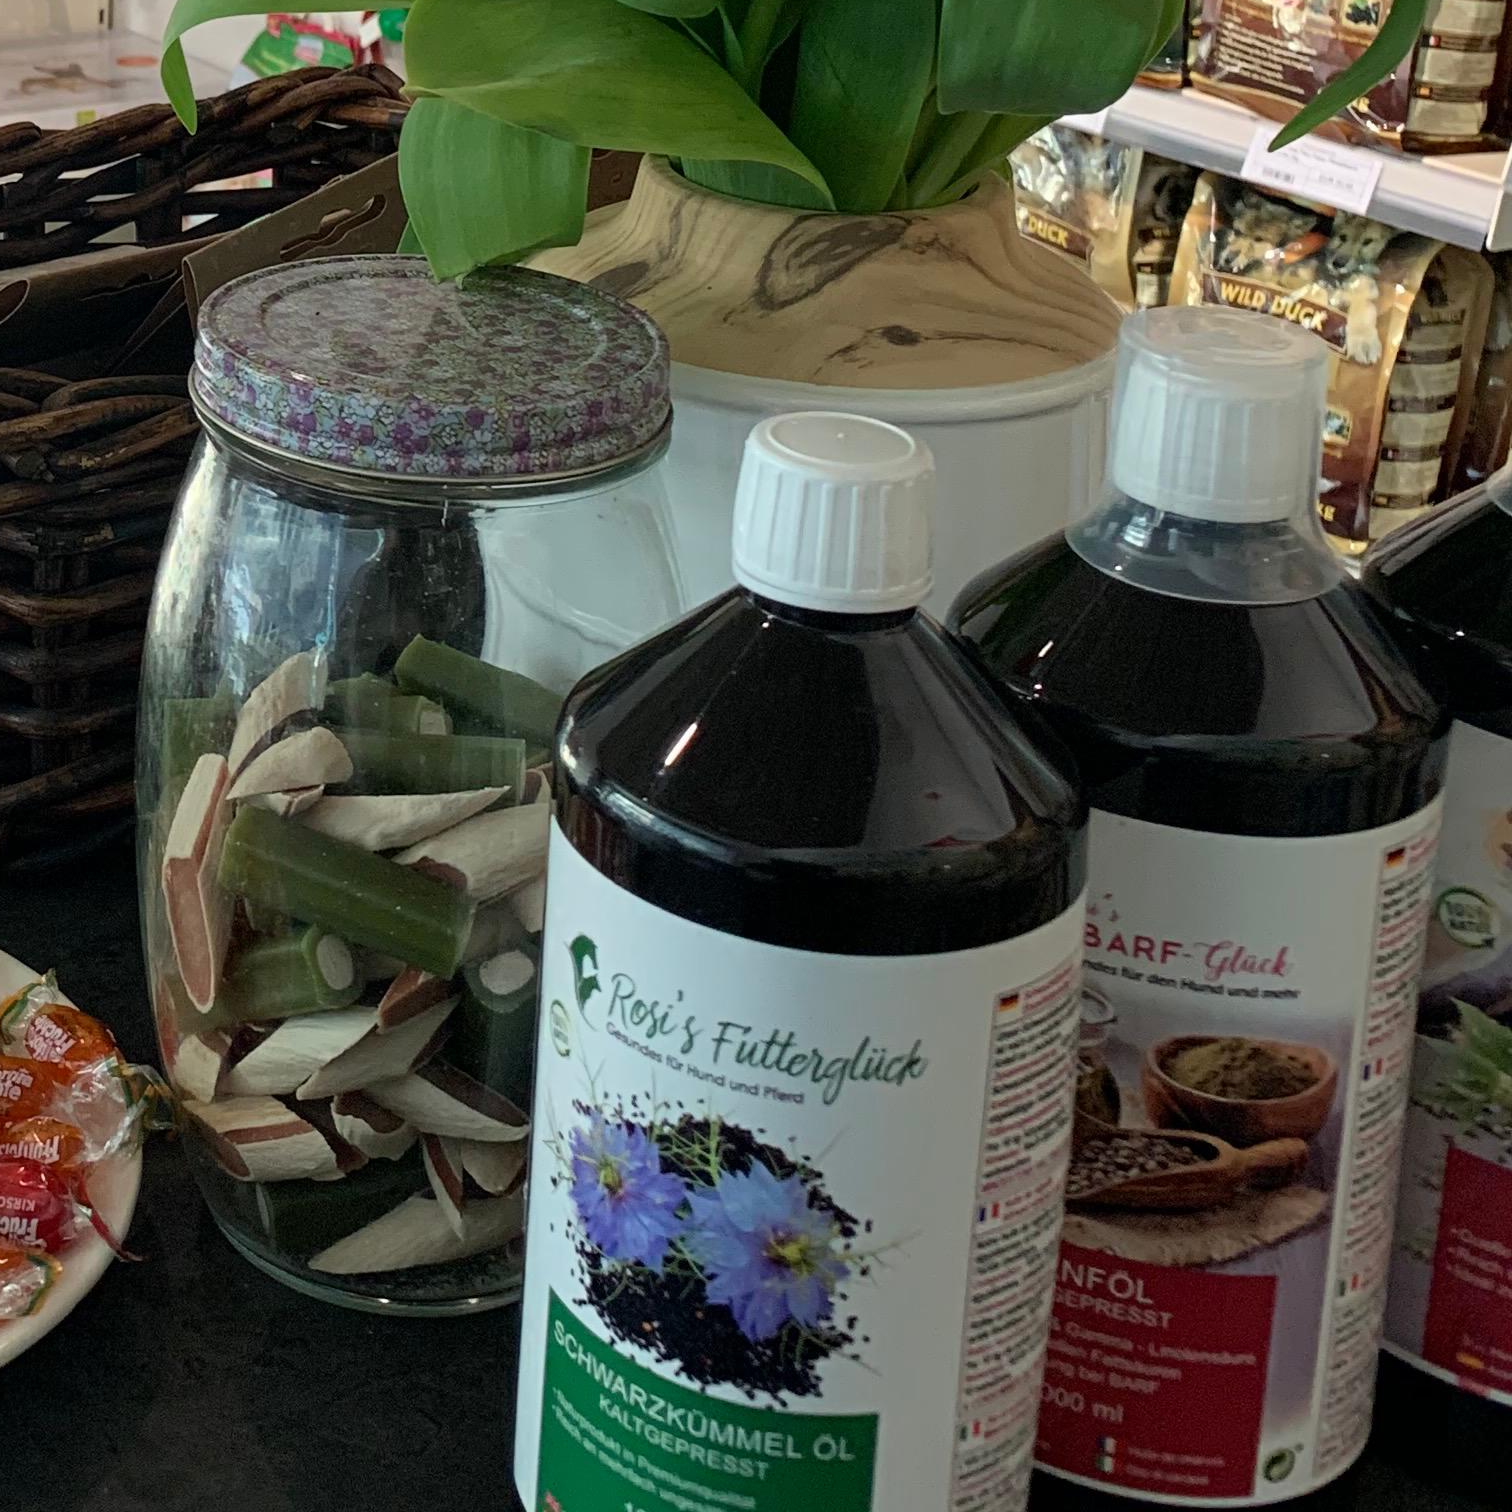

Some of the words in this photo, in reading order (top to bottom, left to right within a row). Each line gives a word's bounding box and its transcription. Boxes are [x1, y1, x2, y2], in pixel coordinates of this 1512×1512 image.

[1027, 216, 1069, 248] DUCK
[1220, 281, 1267, 312] WILD
[1270, 293, 1328, 334] DUCK
[605, 1021, 664, 1065] Gesundes
[665, 1053, 685, 1072] für
[687, 1062, 727, 1089] Hund
[729, 1078, 760, 1097] und
[762, 1085, 806, 1105] Pferd
[608, 973, 704, 1054] Rosi's
[711, 1020, 930, 1106] Futterglück
[1055, 1287, 1175, 1330] GEPRESST
[1060, 1258, 1155, 1306] NFÖL
[553, 1319, 803, 1461] SCHWARZKÜMMEL
[812, 1433, 857, 1462] ÖL
[599, 1393, 770, 1481] KALTGEPRESST
